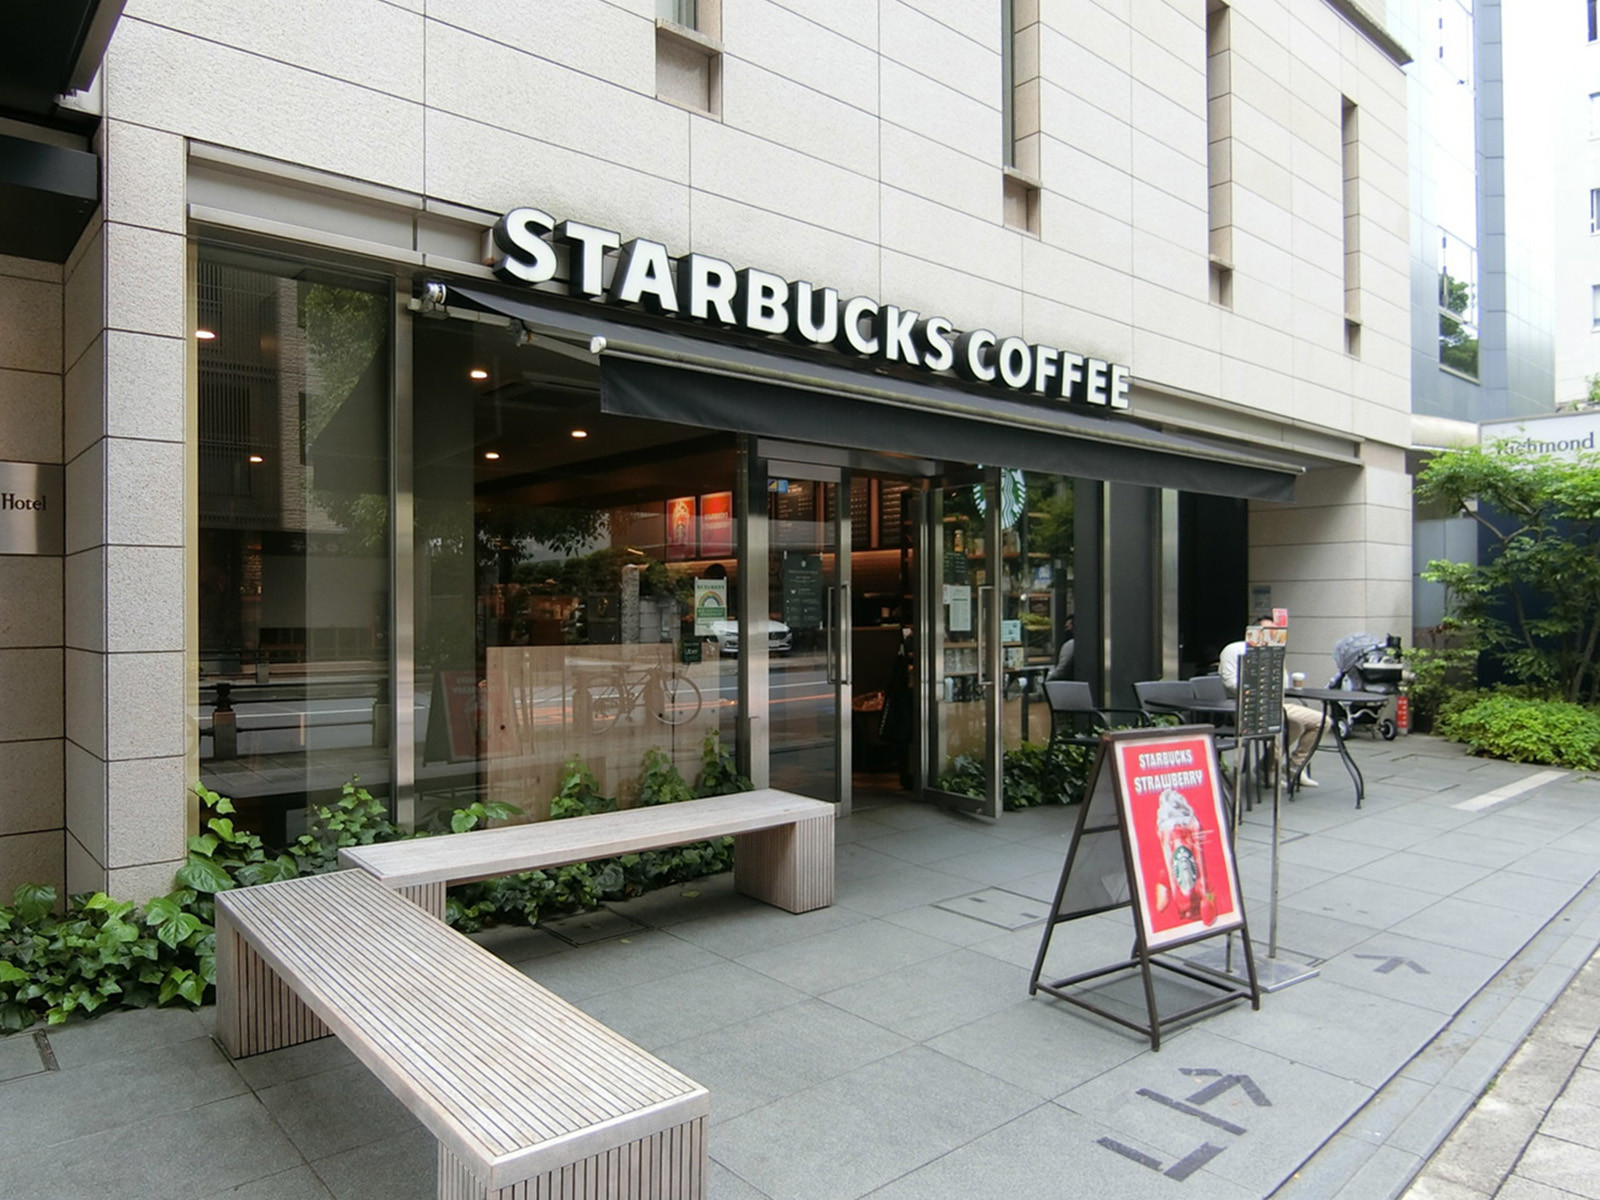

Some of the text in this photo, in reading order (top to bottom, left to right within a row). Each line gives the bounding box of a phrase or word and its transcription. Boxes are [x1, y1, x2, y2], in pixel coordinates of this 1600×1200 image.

[502, 206, 1131, 410] STARBUCKS COFFEE
[1, 493, 47, 511] Hotel
[1138, 749, 1193, 769] STARBUCKS
[1134, 769, 1203, 795] STRAWBERRY
